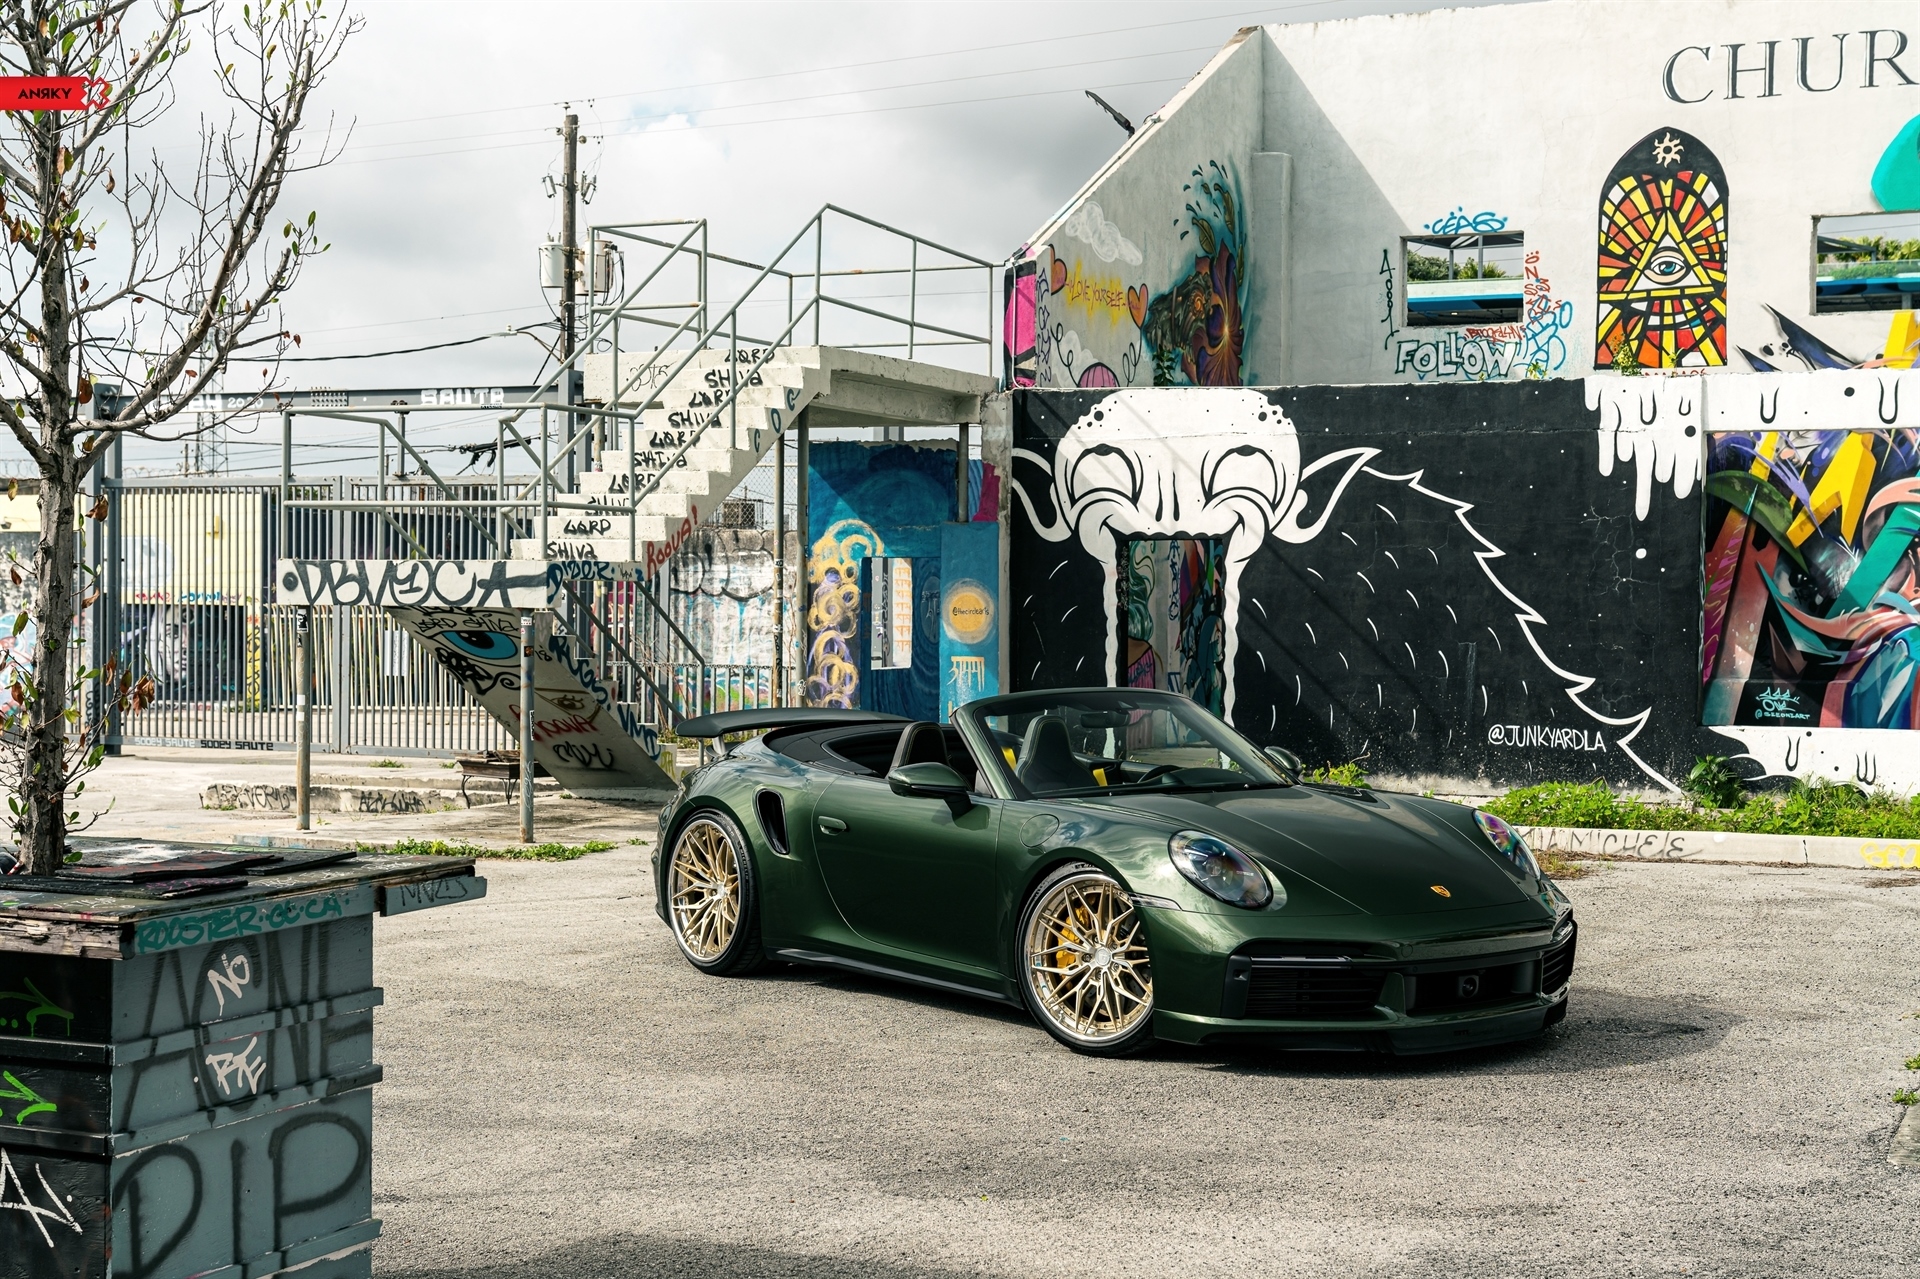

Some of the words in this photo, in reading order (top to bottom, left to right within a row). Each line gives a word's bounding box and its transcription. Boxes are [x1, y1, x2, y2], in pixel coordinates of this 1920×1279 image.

[1662, 29, 1920, 104] CHUR
[1395, 332, 1520, 378] FOLLOW
[1488, 724, 1607, 753] @JUNKYARDLA
[136, 905, 262, 955] ROOSTER
